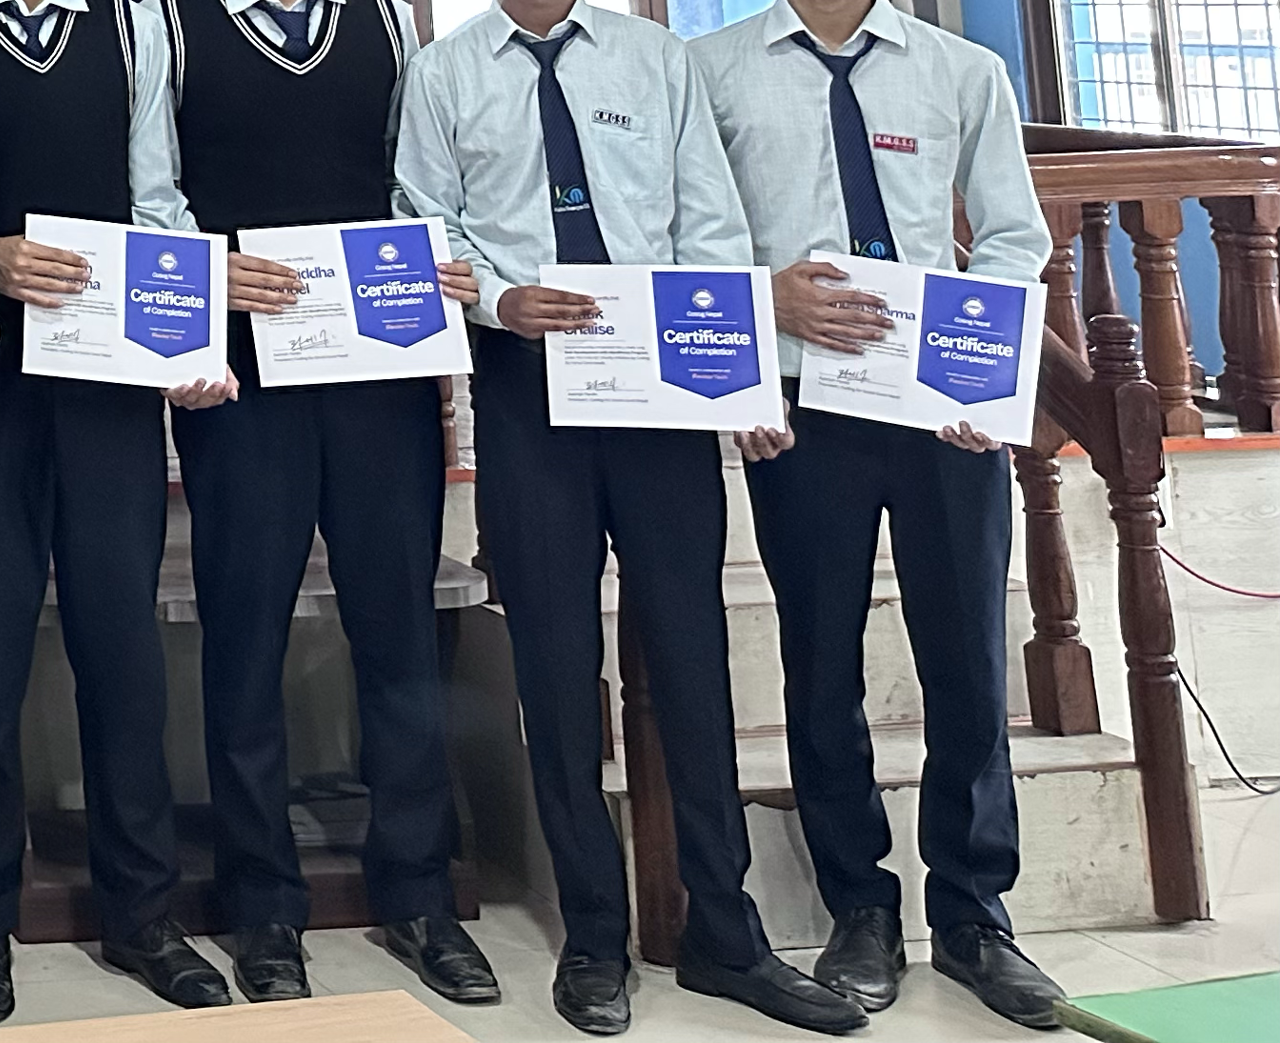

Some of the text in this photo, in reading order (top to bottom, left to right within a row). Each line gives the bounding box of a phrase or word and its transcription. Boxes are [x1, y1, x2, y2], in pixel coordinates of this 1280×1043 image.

[357, 280, 435, 298] Certificate
[130, 288, 205, 309] Certificate
[372, 296, 424, 307] of Completion
[143, 306, 192, 318] of Completion
[663, 329, 751, 345] Certificate
[926, 332, 1015, 358] Certificate
[679, 346, 737, 357] of Completion
[940, 350, 997, 366] of Completion
